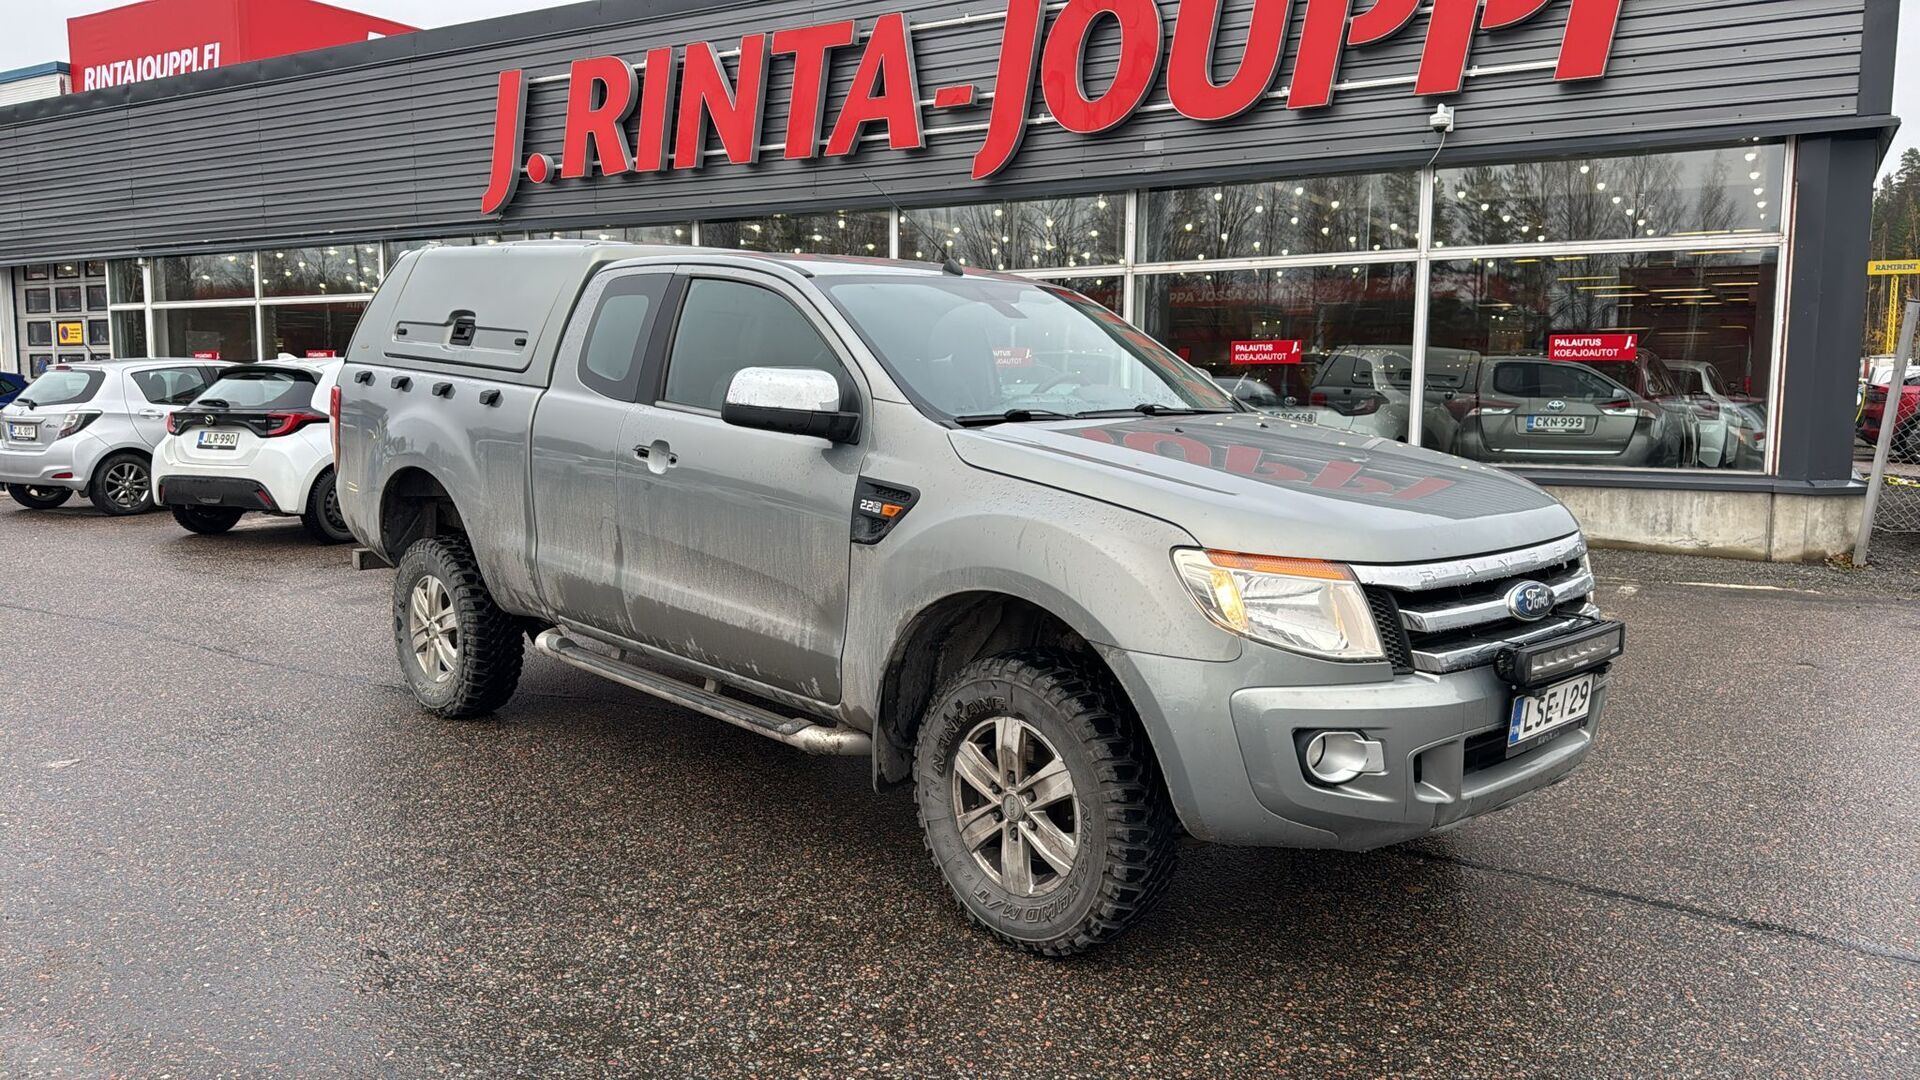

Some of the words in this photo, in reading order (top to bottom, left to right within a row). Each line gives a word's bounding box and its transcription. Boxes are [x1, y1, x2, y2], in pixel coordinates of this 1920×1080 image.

[1235, 344, 1273, 352] PALAUTUS
[1555, 338, 1601, 347] PALAUTUS
[1235, 352, 1287, 361] KOEAJOAUTOT
[1554, 348, 1619, 357] KOEAJOAUTOT
[1535, 417, 1583, 428] CKN-999
[203, 433, 235, 445] JLR-990
[1418, 540, 1586, 589] RANGER
[1525, 588, 1550, 612] Ford
[1522, 680, 1590, 733] LSE-129
